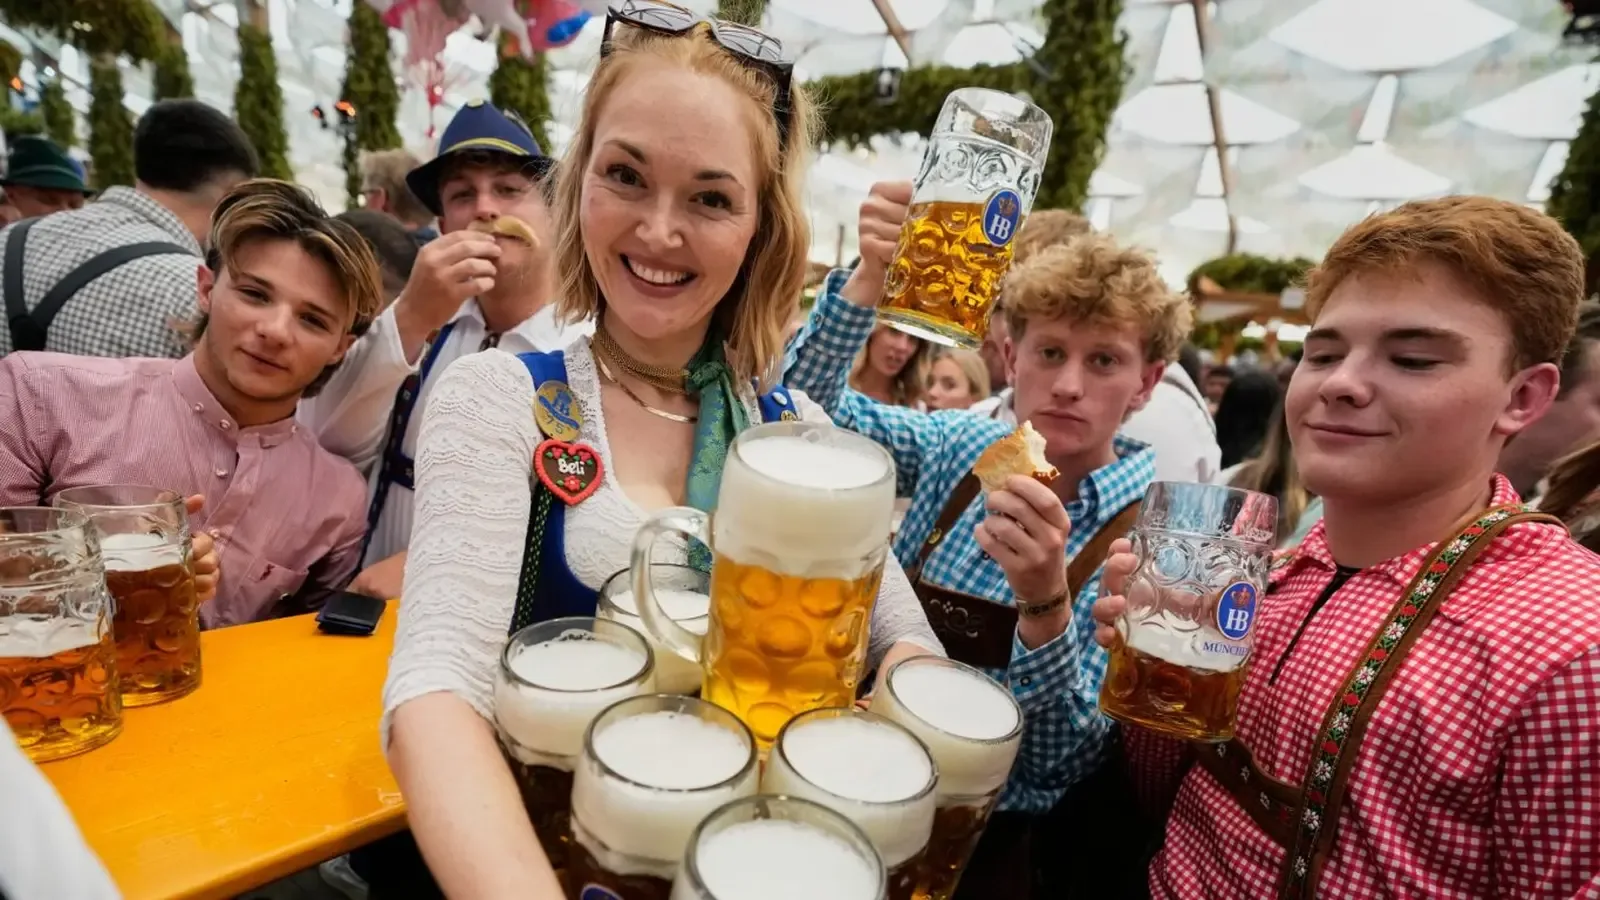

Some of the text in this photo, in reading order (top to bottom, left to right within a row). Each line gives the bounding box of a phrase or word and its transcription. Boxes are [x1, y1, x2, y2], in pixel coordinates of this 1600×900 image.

[988, 213, 1011, 240] HB
[558, 458, 585, 475] Beli
[1224, 608, 1249, 631] HB
